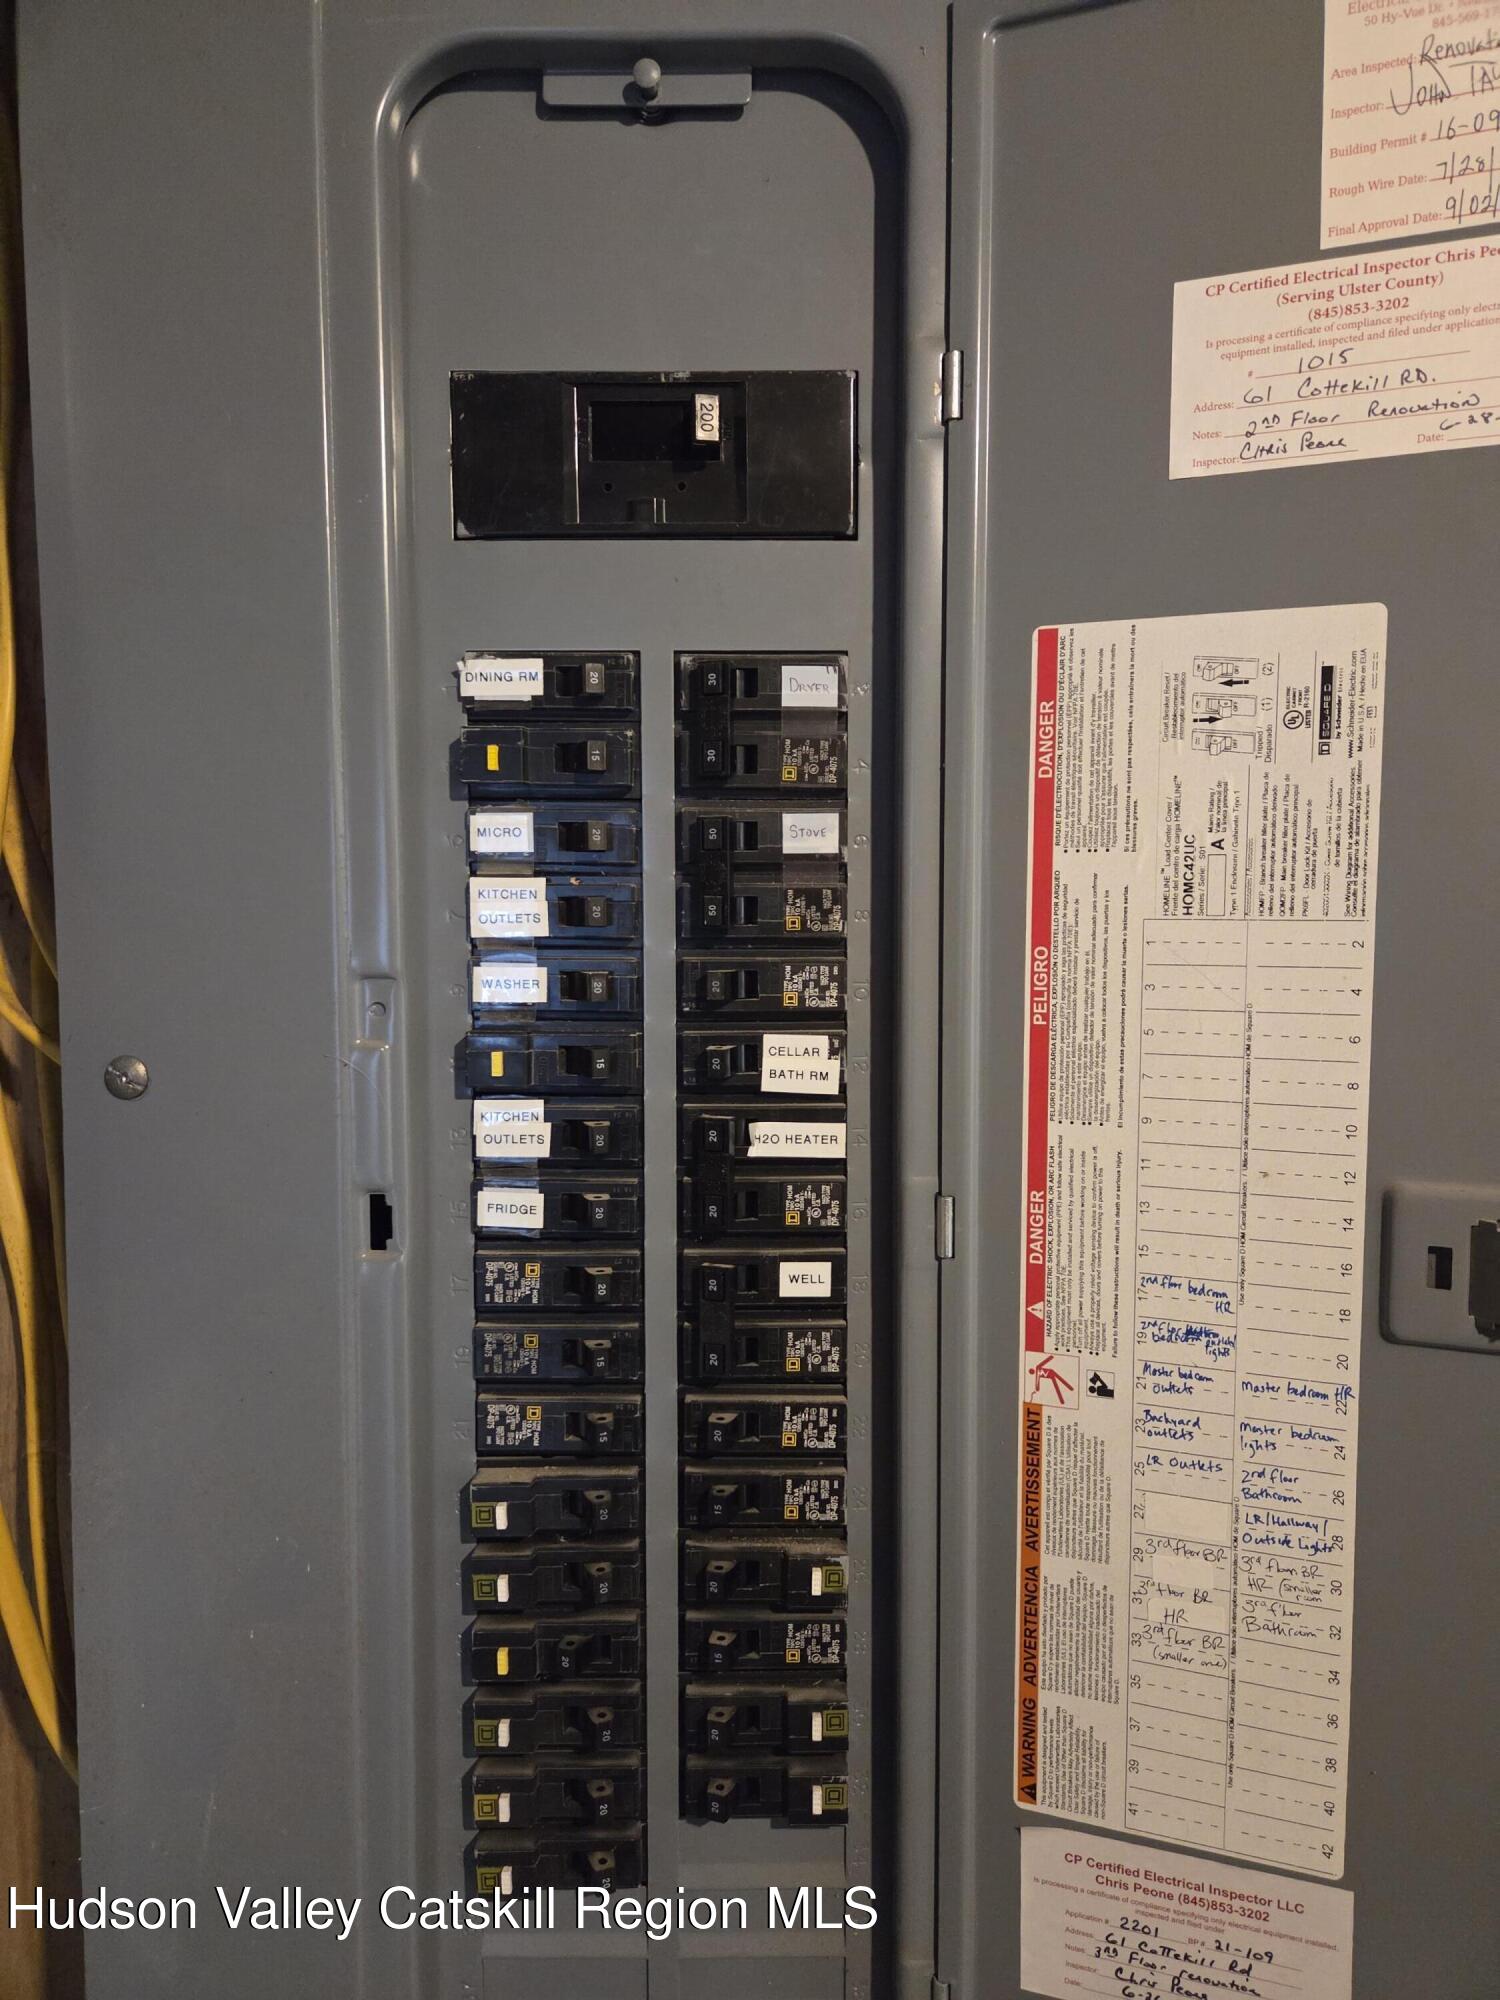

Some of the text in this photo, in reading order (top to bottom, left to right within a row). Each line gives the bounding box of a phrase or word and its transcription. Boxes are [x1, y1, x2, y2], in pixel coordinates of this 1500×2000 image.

[1331, 54, 1417, 80] Area Inspected:
[1331, 103, 1385, 119] Inspector:
[1330, 136, 1417, 159] Building Permit
[1329, 176, 1428, 198] Rough Wire Date:
[1328, 211, 1442, 237] Final Approval Date:
[1205, 249, 1475, 297] CP Certified Electrical Inspector Chris
[1276, 271, 1444, 307] (Serving Ulster County)
[1308, 297, 1409, 323] (845)853-3202
[1216, 309, 1446, 350] processing certificate compliance specifying
[1220, 347, 1270, 362] equipment
[1318, 334, 1364, 349] inspected
[1298, 348, 1354, 374] 1015
[1244, 386, 1271, 404] 61
[1193, 402, 1235, 413] Address:
[1291, 390, 1480, 427] Floor Renovation
[700, 402, 714, 433] 200
[1192, 431, 1222, 440] Notes:
[1417, 433, 1444, 443] Date:
[1192, 457, 1241, 469] Inspector:
[465, 671, 539, 683] DINING RM
[589, 671, 599, 684] 20
[707, 673, 717, 686] 30
[1037, 700, 1056, 779] DANGER
[707, 749, 716, 762] 30
[477, 827, 522, 837] MICRO
[591, 829, 601, 841] 20
[708, 828, 718, 840] 50
[1211, 838, 1225, 850] A
[1182, 834, 1196, 916] HOMC42UC
[477, 889, 538, 899] KITCHEN
[708, 904, 717, 917] 50
[478, 913, 541, 924] OUTLETS
[1353, 940, 1365, 948] 2
[481, 979, 540, 990] WASHER
[593, 981, 602, 994] 20
[711, 981, 720, 993] 20
[1033, 945, 1048, 1026] PELIGRO
[1350, 987, 1362, 996] 4
[768, 1047, 820, 1057] CELLAR
[712, 1058, 721, 1070] 20
[769, 1069, 829, 1081] BATH RM
[1348, 1082, 1359, 1090] 8
[480, 1111, 539, 1122] KITCHEN
[483, 1134, 545, 1145] OUTLETS
[708, 1130, 718, 1143] 20
[754, 1133, 838, 1145] H2O HEATER
[1345, 1125, 1358, 1139] 10
[487, 1203, 537, 1215] FRIDGE
[595, 1207, 604, 1219] 20
[708, 1205, 718, 1218] 20
[1140, 1201, 1150, 1214] 13
[1029, 1189, 1045, 1265] DANGER
[1342, 1217, 1355, 1232] 14
[1341, 1263, 1353, 1277] 16
[788, 1274, 825, 1284] WELL
[1340, 1309, 1352, 1323] 18
[1336, 1354, 1349, 1370] 20
[1287, 1382, 1329, 1400] bedroom
[714, 1430, 723, 1442] 20
[1334, 1445, 1346, 1461] 24
[1134, 1461, 1145, 1476] 25
[1024, 1407, 1042, 1552] AVERTISSEMENT
[1241, 1487, 1303, 1504] Bathroom
[1333, 1490, 1345, 1505] 26
[1164, 1608, 1189, 1624] HR
[1023, 1564, 1039, 1687] ADVERTENCIA
[1330, 1625, 1342, 1640] 32
[1131, 1632, 1142, 1647] 33
[1202, 1635, 1226, 1650] BR
[1129, 1717, 1140, 1732] 37
[1327, 1714, 1339, 1729] 36
[1021, 1697, 1037, 1778] WARNING
[1325, 1758, 1338, 1773] 38
[1324, 1801, 1336, 1816] 40
[1321, 1844, 1334, 1859] 42
[1064, 1853, 1305, 1914] CP Certified Electrical Inspector LLC
[1095, 1875, 1270, 1922] Chris Peone (845)853-3202
[1119, 1916, 1159, 1937] 2201
[1105, 1933, 1126, 1947] 61
[1214, 1939, 1274, 1964] 21-109
